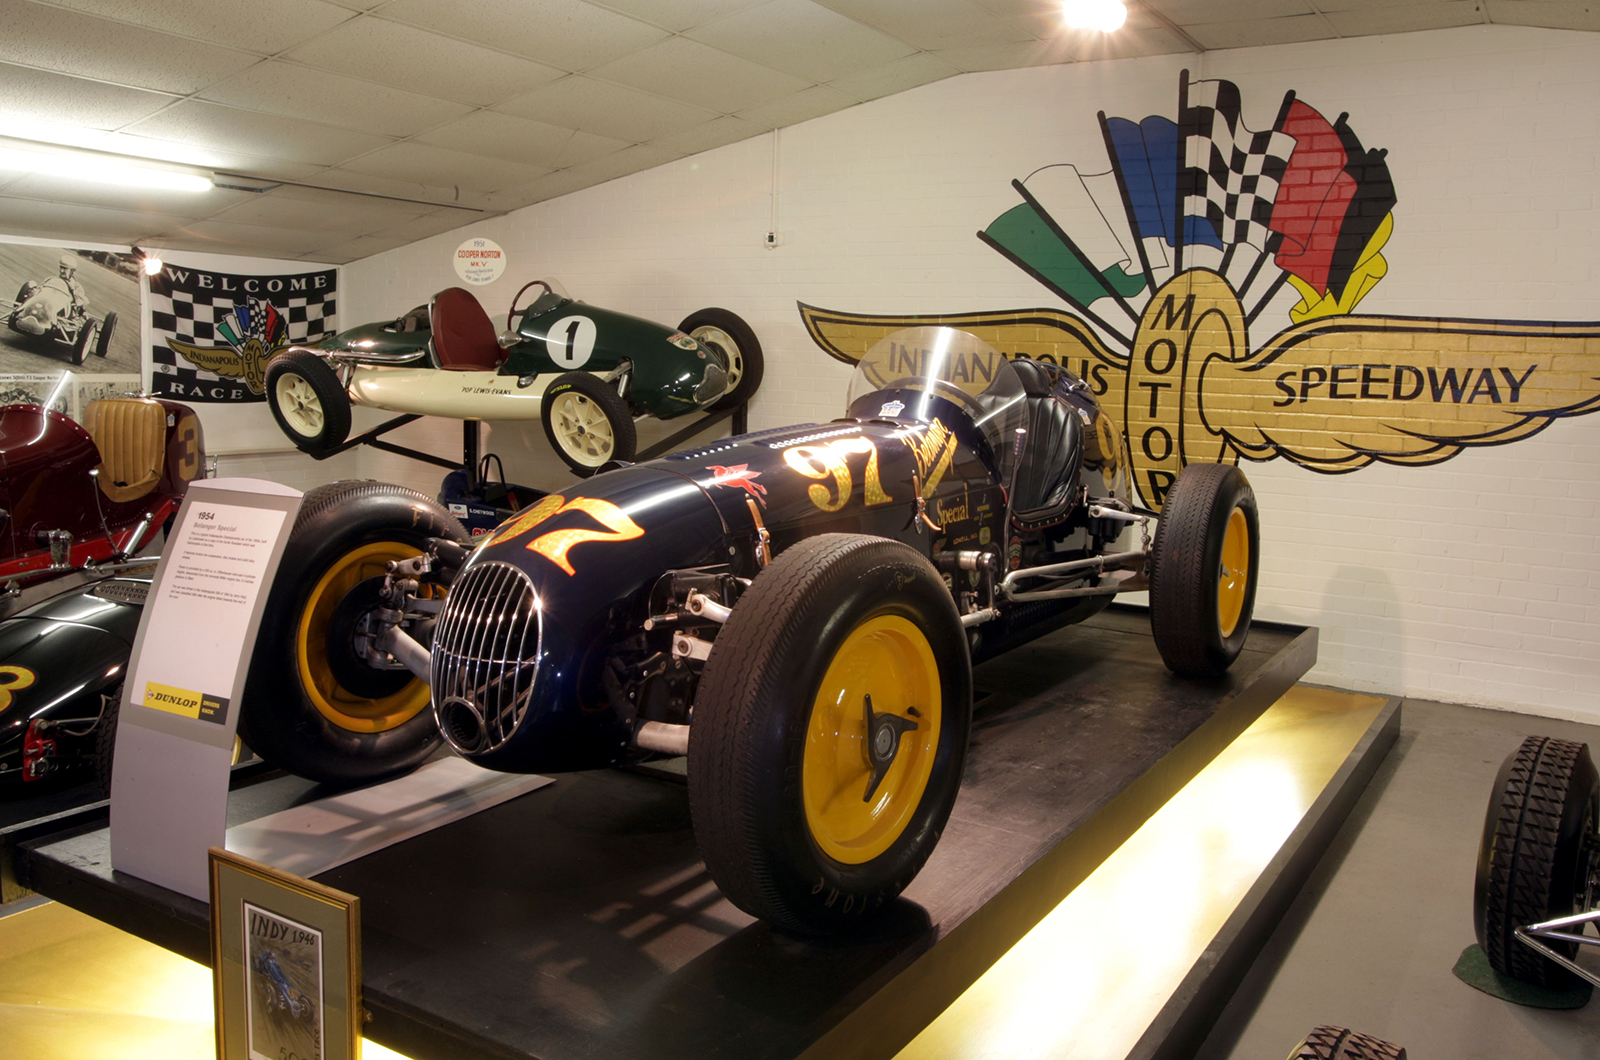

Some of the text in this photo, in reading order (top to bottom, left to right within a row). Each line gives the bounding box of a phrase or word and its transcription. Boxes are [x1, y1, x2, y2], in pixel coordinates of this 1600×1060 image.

[458, 250, 501, 258] COOPER NORTON
[166, 267, 328, 293] WELCOME
[565, 321, 580, 361] 1
[190, 350, 240, 366] INDIANAPOLIS
[245, 344, 260, 389] MOTOR
[170, 382, 244, 400] RACE
[1138, 293, 1197, 505] MOTOR
[1273, 364, 1538, 407] SPEEDWAY
[178, 414, 199, 481] 3
[784, 436, 893, 512] 97
[198, 511, 215, 520] 1954
[936, 482, 970, 534] Special
[193, 522, 237, 532] Belanger Special
[155, 692, 197, 708] DUNLOP
[251, 913, 315, 946] INDY 1946
